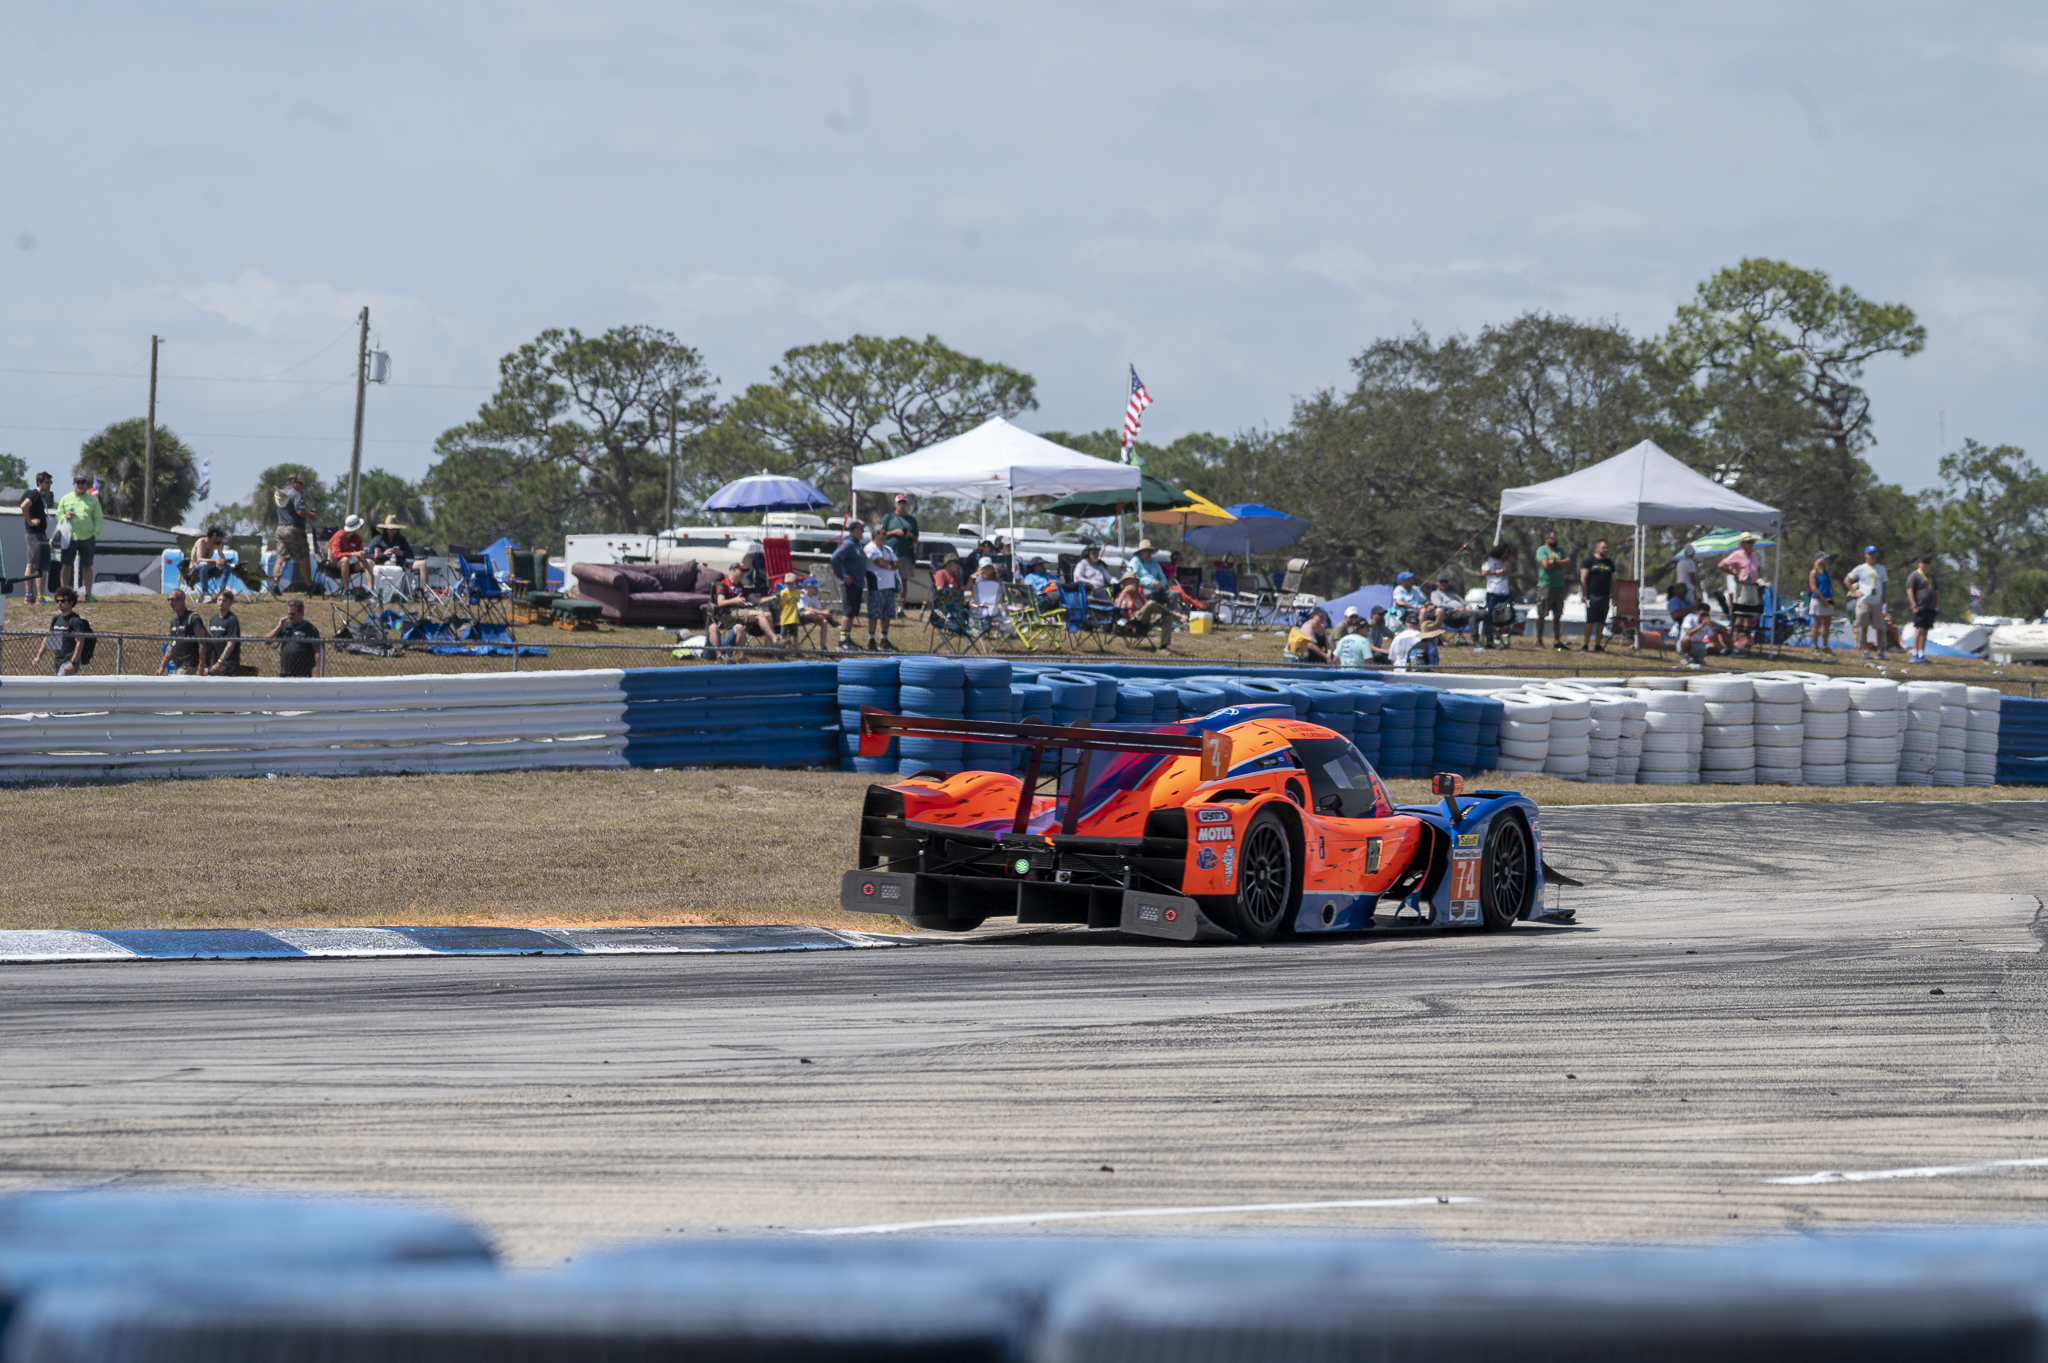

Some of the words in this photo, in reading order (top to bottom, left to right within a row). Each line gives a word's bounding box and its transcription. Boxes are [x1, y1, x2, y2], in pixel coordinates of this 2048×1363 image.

[1210, 739, 1221, 777] 74
[1198, 827, 1234, 841] MOTUL
[1198, 847, 1213, 869] VP
[1457, 861, 1475, 898] 74
